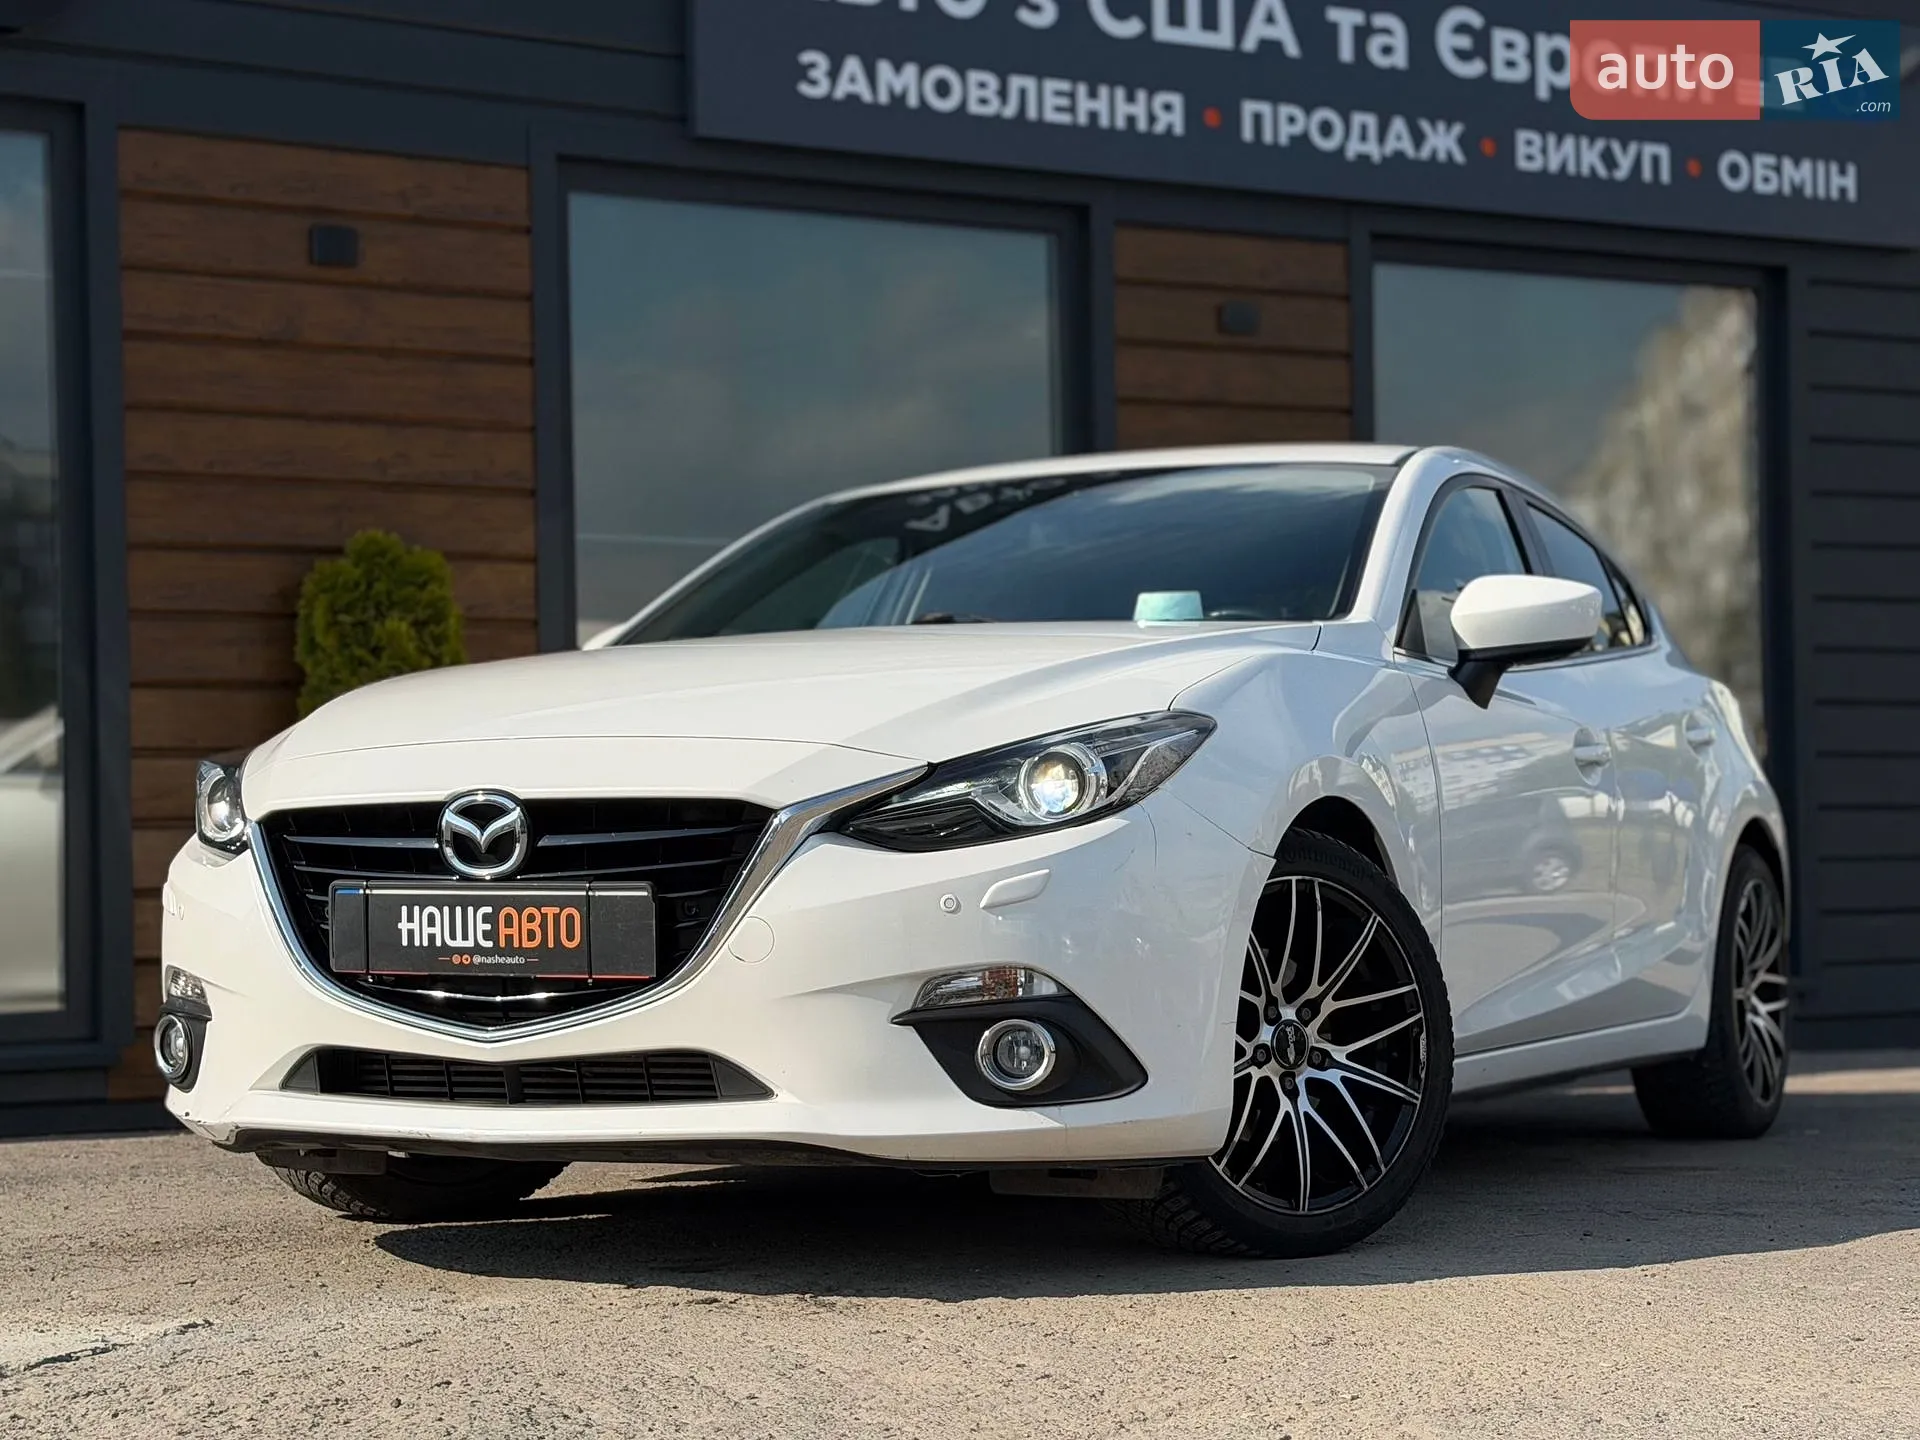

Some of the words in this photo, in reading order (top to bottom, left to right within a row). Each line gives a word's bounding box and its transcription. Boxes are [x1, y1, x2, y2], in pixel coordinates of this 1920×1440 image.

[1324, 5, 1410, 71] та
[797, 49, 1186, 137] ЗАМОВЛЕННЯ
[1240, 98, 1467, 165] ПРОДАЖ
[1514, 128, 1671, 185] ВИКУП
[1717, 149, 1858, 203] ОБМІН
[397, 905, 493, 948] НАШЕ
[498, 906, 581, 949] АВТО
[472, 954, 525, 966] @nasheauto
